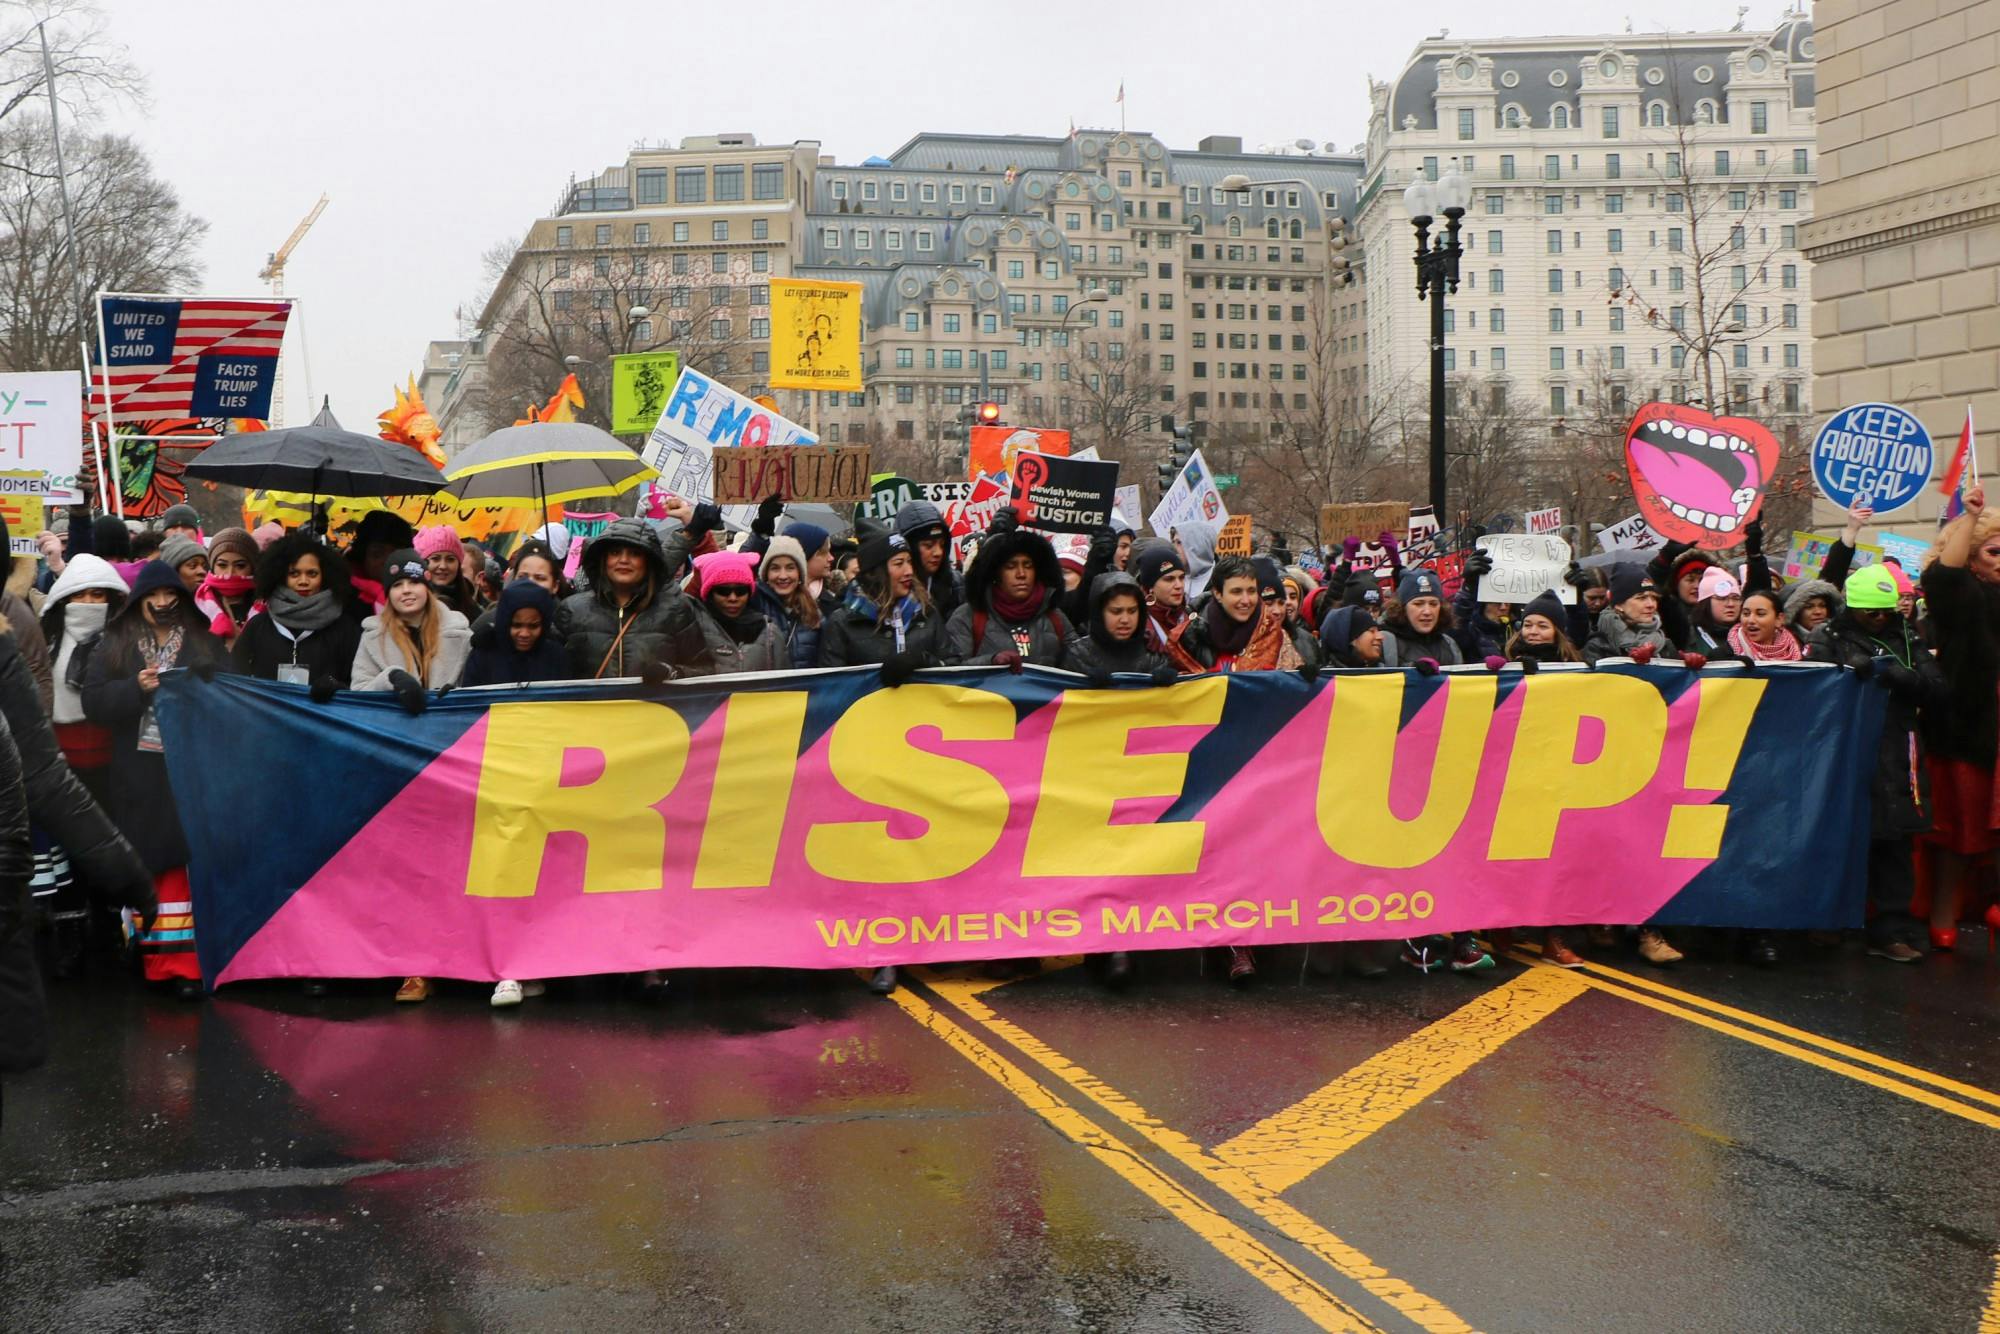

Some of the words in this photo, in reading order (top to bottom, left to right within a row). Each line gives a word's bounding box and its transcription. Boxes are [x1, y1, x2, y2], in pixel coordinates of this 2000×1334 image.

[785, 289, 795, 297] LET
[822, 290, 848, 299] BLOSSOM
[113, 313, 165, 326] UNITED
[124, 328, 145, 341] WE
[110, 344, 154, 358] STAND
[217, 363, 258, 377] FACTS
[785, 369, 793, 377] NO
[794, 369, 811, 377] MORE
[812, 369, 825, 377] KIDS
[832, 370, 850, 378] CAGES
[214, 379, 258, 392] TRUMP
[219, 395, 247, 408] LIES
[1844, 406, 1917, 441] KEEP
[1819, 429, 1928, 476] ABORTION
[1824, 459, 1911, 500] LEGAL
[1029, 494, 1060, 506] march
[1061, 499, 1076, 508] for
[1031, 484, 1064, 497] Jewish
[1066, 489, 1100, 500] Women
[863, 483, 913, 520] ERA
[1027, 506, 1104, 526] JUSTICE
[1531, 510, 1560, 532] MAKE
[1612, 519, 1647, 545] MAD
[1219, 537, 1243, 550] OUT
[1484, 535, 1537, 563] YES
[1489, 567, 1548, 595] CAN
[465, 675, 1228, 898] RISE
[1315, 671, 1769, 869] UP!
[816, 909, 1082, 948] WOMEN'S
[1101, 900, 1300, 935] MARCH
[1317, 890, 1435, 926] 2020
